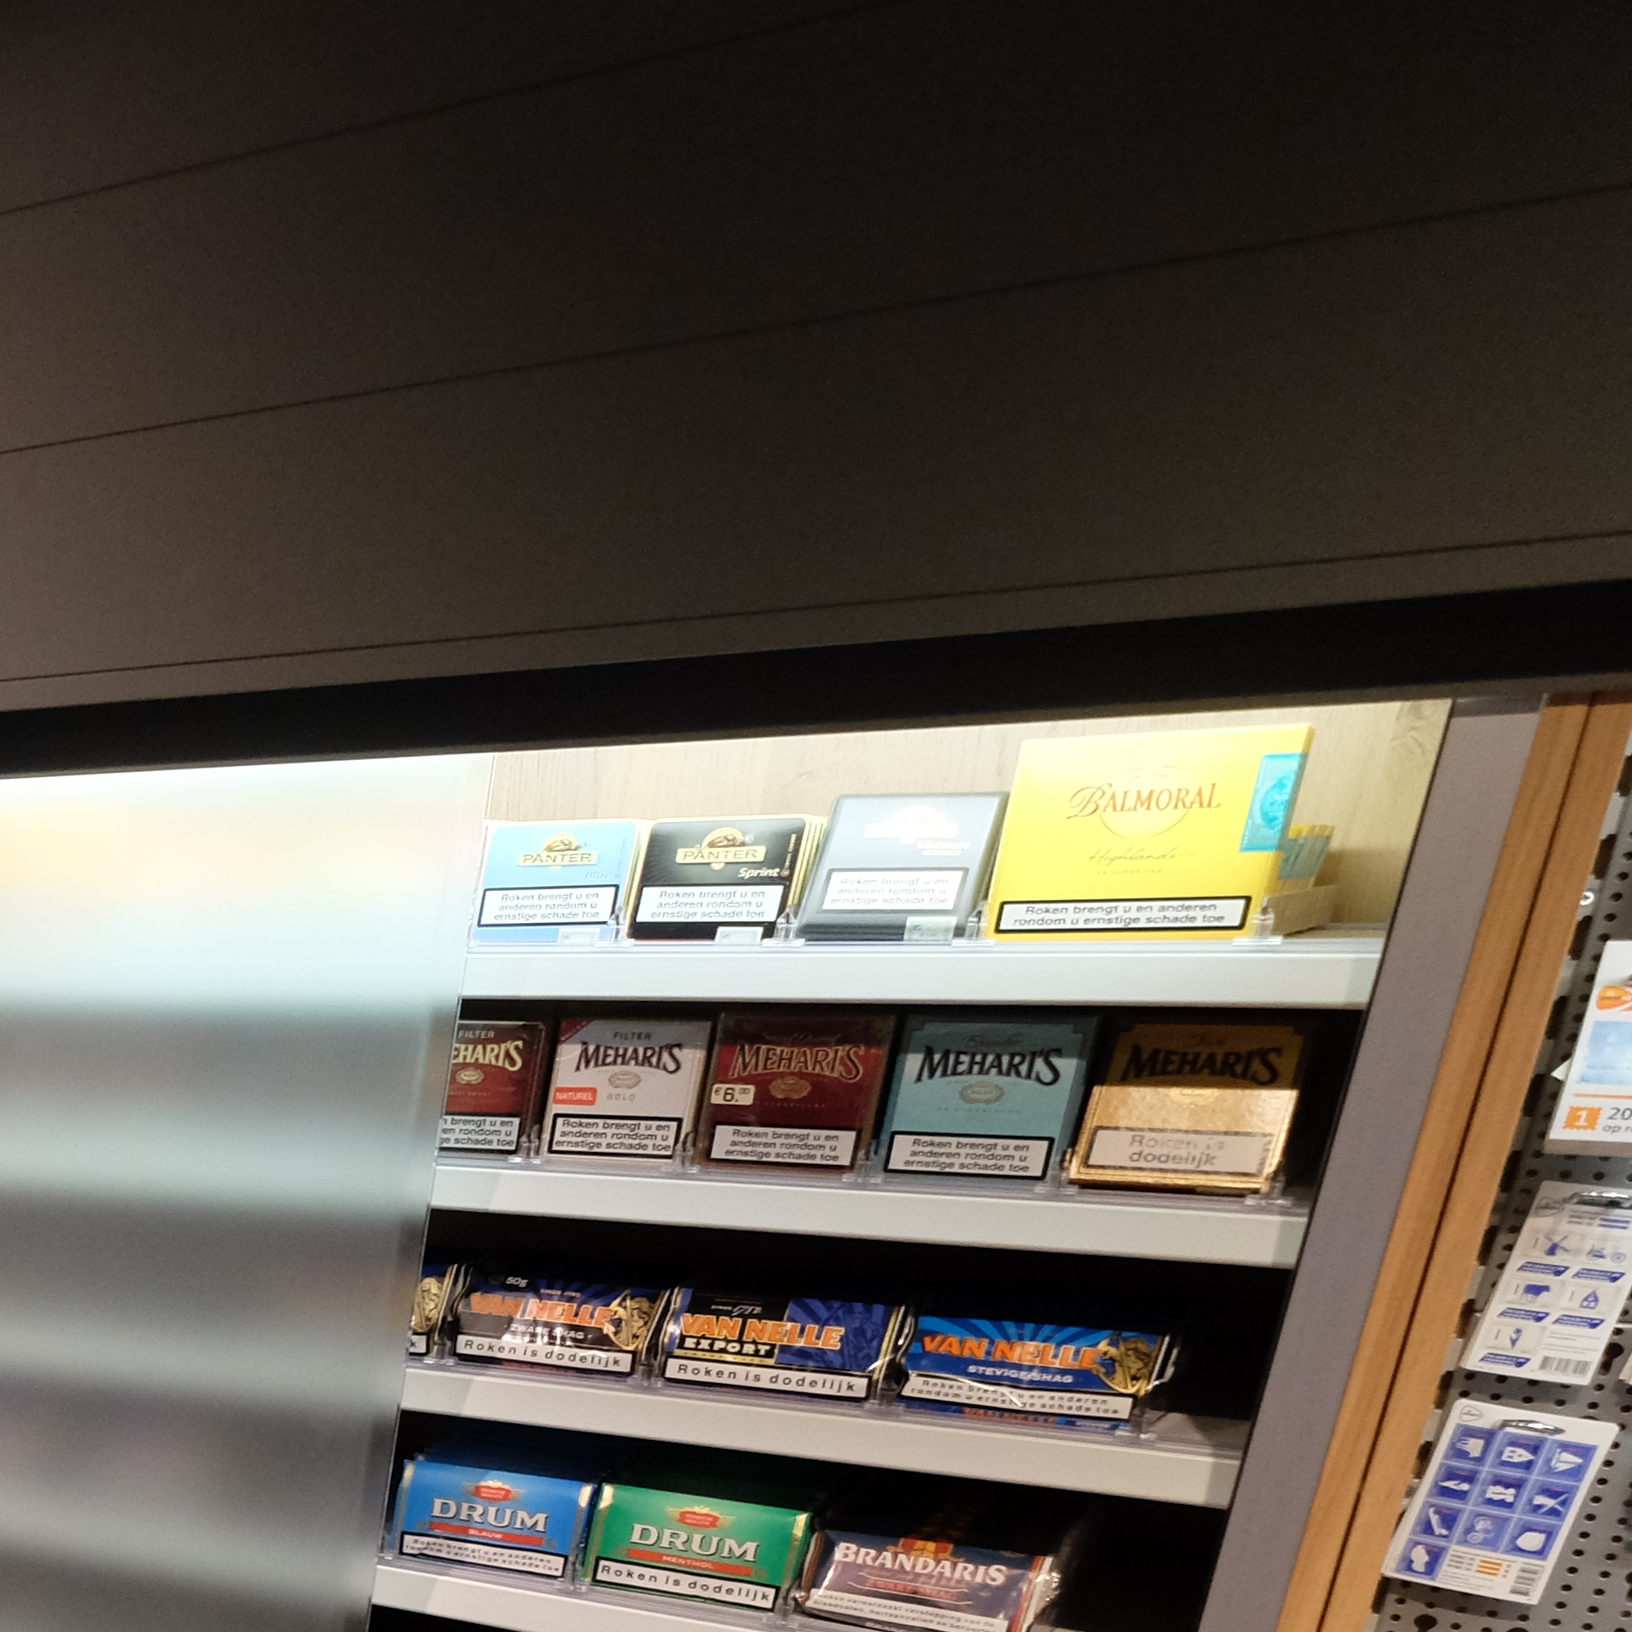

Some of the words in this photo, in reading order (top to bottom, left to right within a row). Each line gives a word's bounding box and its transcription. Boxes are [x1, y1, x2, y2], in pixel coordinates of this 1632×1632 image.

[1067, 782, 1221, 819] BALMORAL
[523, 853, 592, 864] PANTER
[683, 849, 757, 860] PANTER
[738, 867, 780, 879] Sprint
[659, 890, 695, 898] Roken
[699, 890, 736, 900] brengt
[657, 900, 703, 908] anderen
[706, 900, 752, 908] rondom
[1025, 905, 1069, 915] Roken
[1072, 904, 1119, 917] brengt
[1135, 904, 1153, 913] en
[1157, 903, 1217, 913] anderen
[651, 910, 698, 920] ernstige
[700, 910, 742, 918] schade
[746, 910, 764, 918] toe
[1013, 915, 1066, 926] rondom
[1083, 914, 1140, 927] ernstige
[1144, 913, 1197, 924] schade
[1202, 913, 1225, 924] toe
[458, 1030, 495, 1039] FILTER
[613, 1031, 652, 1041] FILTER
[574, 1041, 683, 1075] MEHARI'S
[729, 1043, 865, 1083] MEHARI'S
[914, 1045, 1062, 1086] MEHARI'S
[1120, 1045, 1282, 1086] MEHARI'S
[555, 1091, 595, 1101] NATUREL
[562, 1119, 599, 1129] Roken
[602, 1120, 642, 1132] brengt
[656, 1123, 670, 1131] en
[1575, 1110, 1588, 1126] 1
[560, 1130, 607, 1140] anderen
[611, 1131, 659, 1141] rondom
[555, 1139, 602, 1151] ernstige
[605, 1141, 649, 1151] schade
[652, 1142, 672, 1152] toe
[505, 1276, 529, 1288] 50g
[471, 1293, 525, 1318] VAN
[527, 1299, 615, 1328] NELLE
[680, 1313, 742, 1340] VAN
[745, 1319, 846, 1351] NELLE
[464, 1340, 517, 1355] Roken
[523, 1347, 538, 1358] is
[545, 1350, 621, 1368] dodelijk
[683, 1337, 772, 1356] EXPORT
[922, 1334, 987, 1360] VAN
[992, 1339, 1103, 1370] NELLE
[677, 1363, 736, 1381] Roken
[744, 1371, 761, 1383] is
[769, 1373, 856, 1393] dodelijk
[431, 1498, 549, 1532] DRUM
[630, 1523, 760, 1562] DRUM
[662, 1555, 715, 1570] MENTHOL
[835, 1542, 1009, 1586] BRANDARIS
[601, 1565, 658, 1583] Roken
[665, 1576, 681, 1587] is
[688, 1580, 770, 1601] dodelijk
